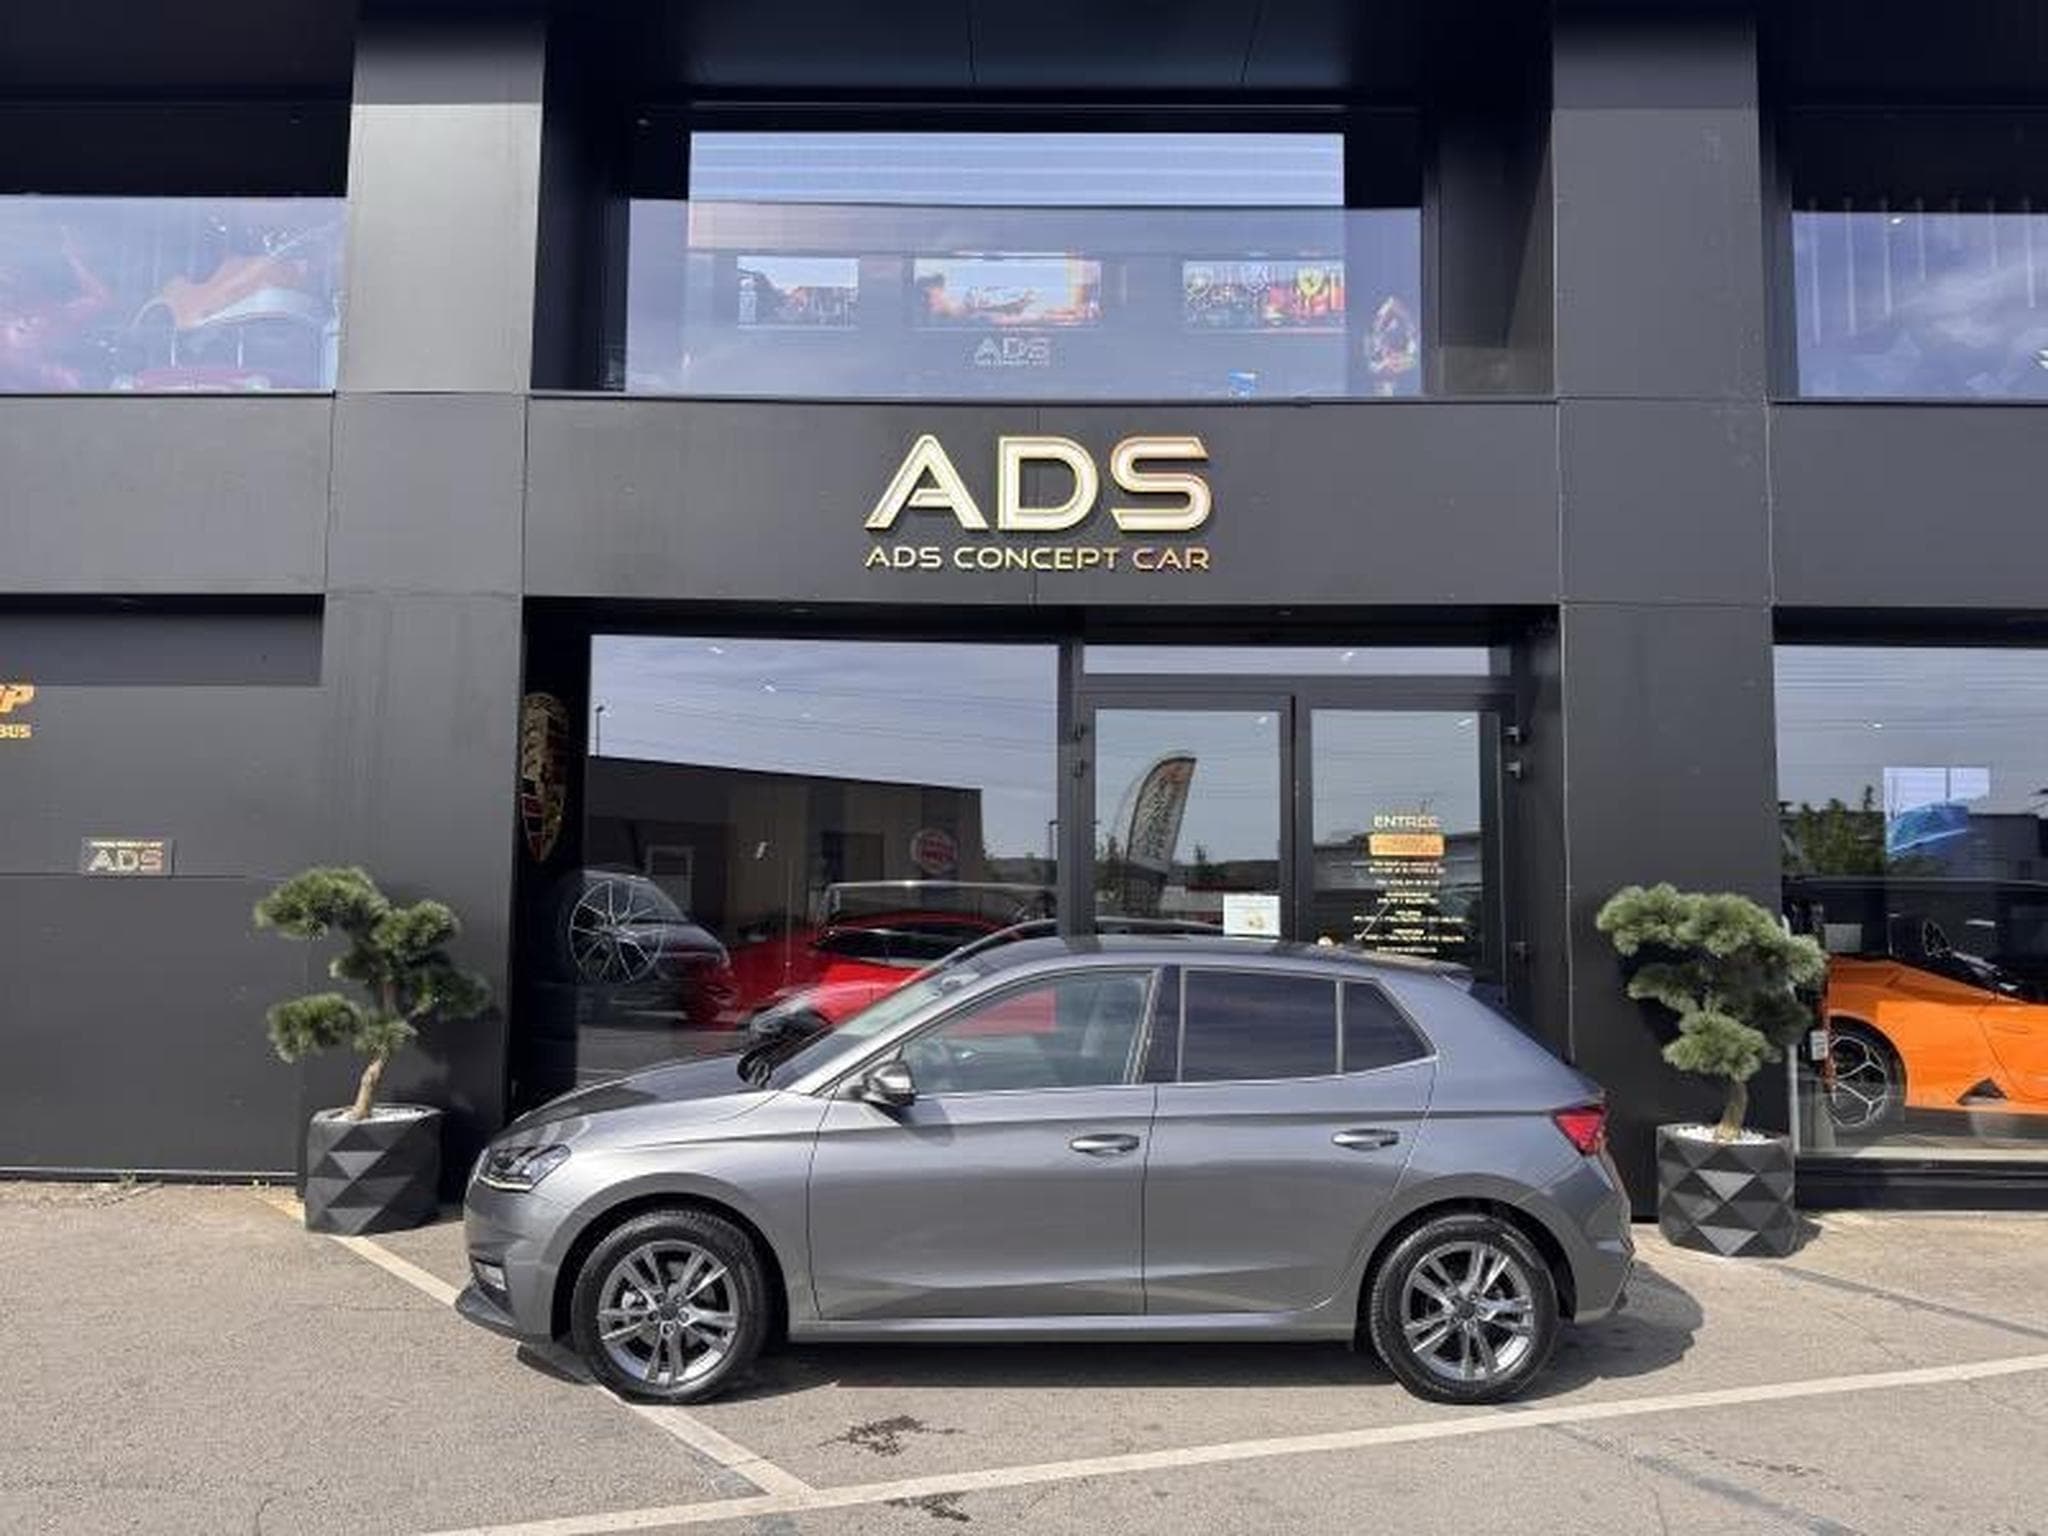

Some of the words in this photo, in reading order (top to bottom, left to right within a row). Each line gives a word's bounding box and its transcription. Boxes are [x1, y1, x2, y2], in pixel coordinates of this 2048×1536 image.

[864, 434, 1212, 530] ADS
[865, 546, 943, 568] ADS
[954, 547, 1119, 570] CONCEPT
[1133, 547, 1210, 571] CAR
[88, 849, 164, 872] ADS
